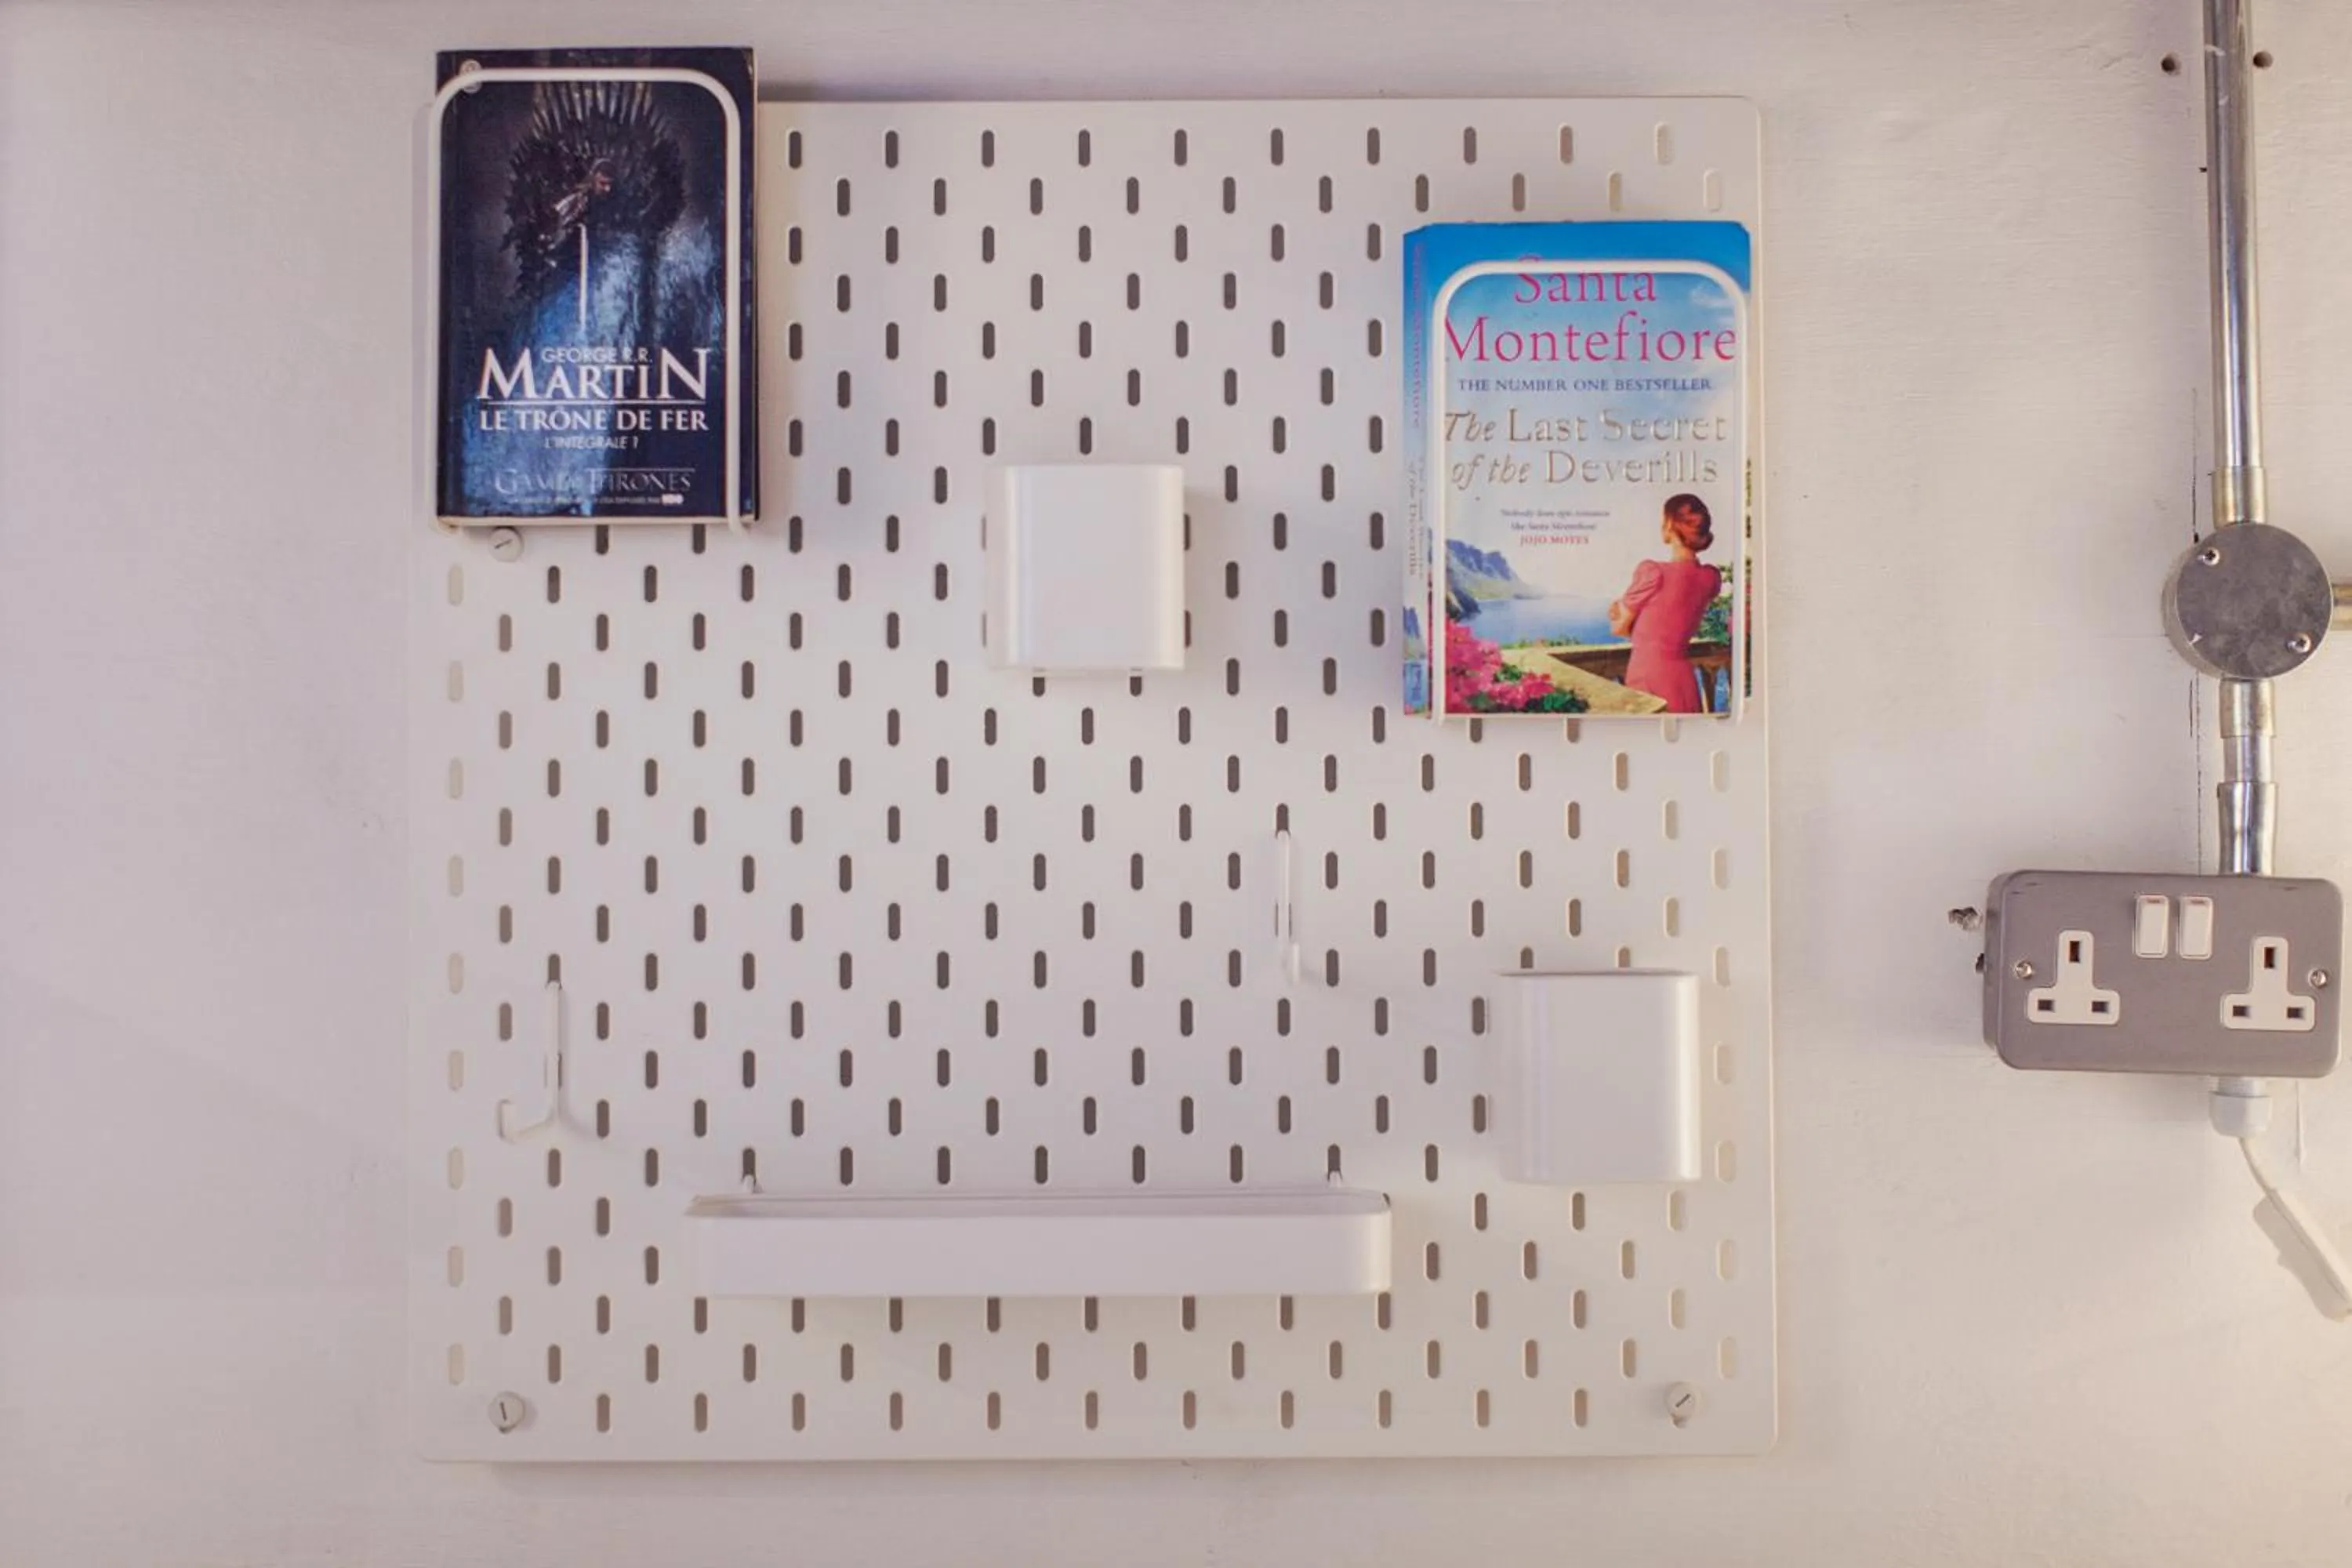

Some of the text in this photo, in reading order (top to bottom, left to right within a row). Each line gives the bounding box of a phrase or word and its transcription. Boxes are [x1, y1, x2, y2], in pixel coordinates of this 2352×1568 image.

[1514, 253, 1656, 304] Santa
[1444, 310, 1737, 361] Montefiore
[476, 347, 713, 400] MARTIN
[541, 347, 617, 364] GEORGE
[1458, 379, 1711, 392] THE NUMBER ONE BESTSELLER
[480, 405, 710, 430] LE TRÔNE DE FER
[1444, 408, 1728, 443] The Last Secret
[1451, 450, 1719, 492] of the Deverills
